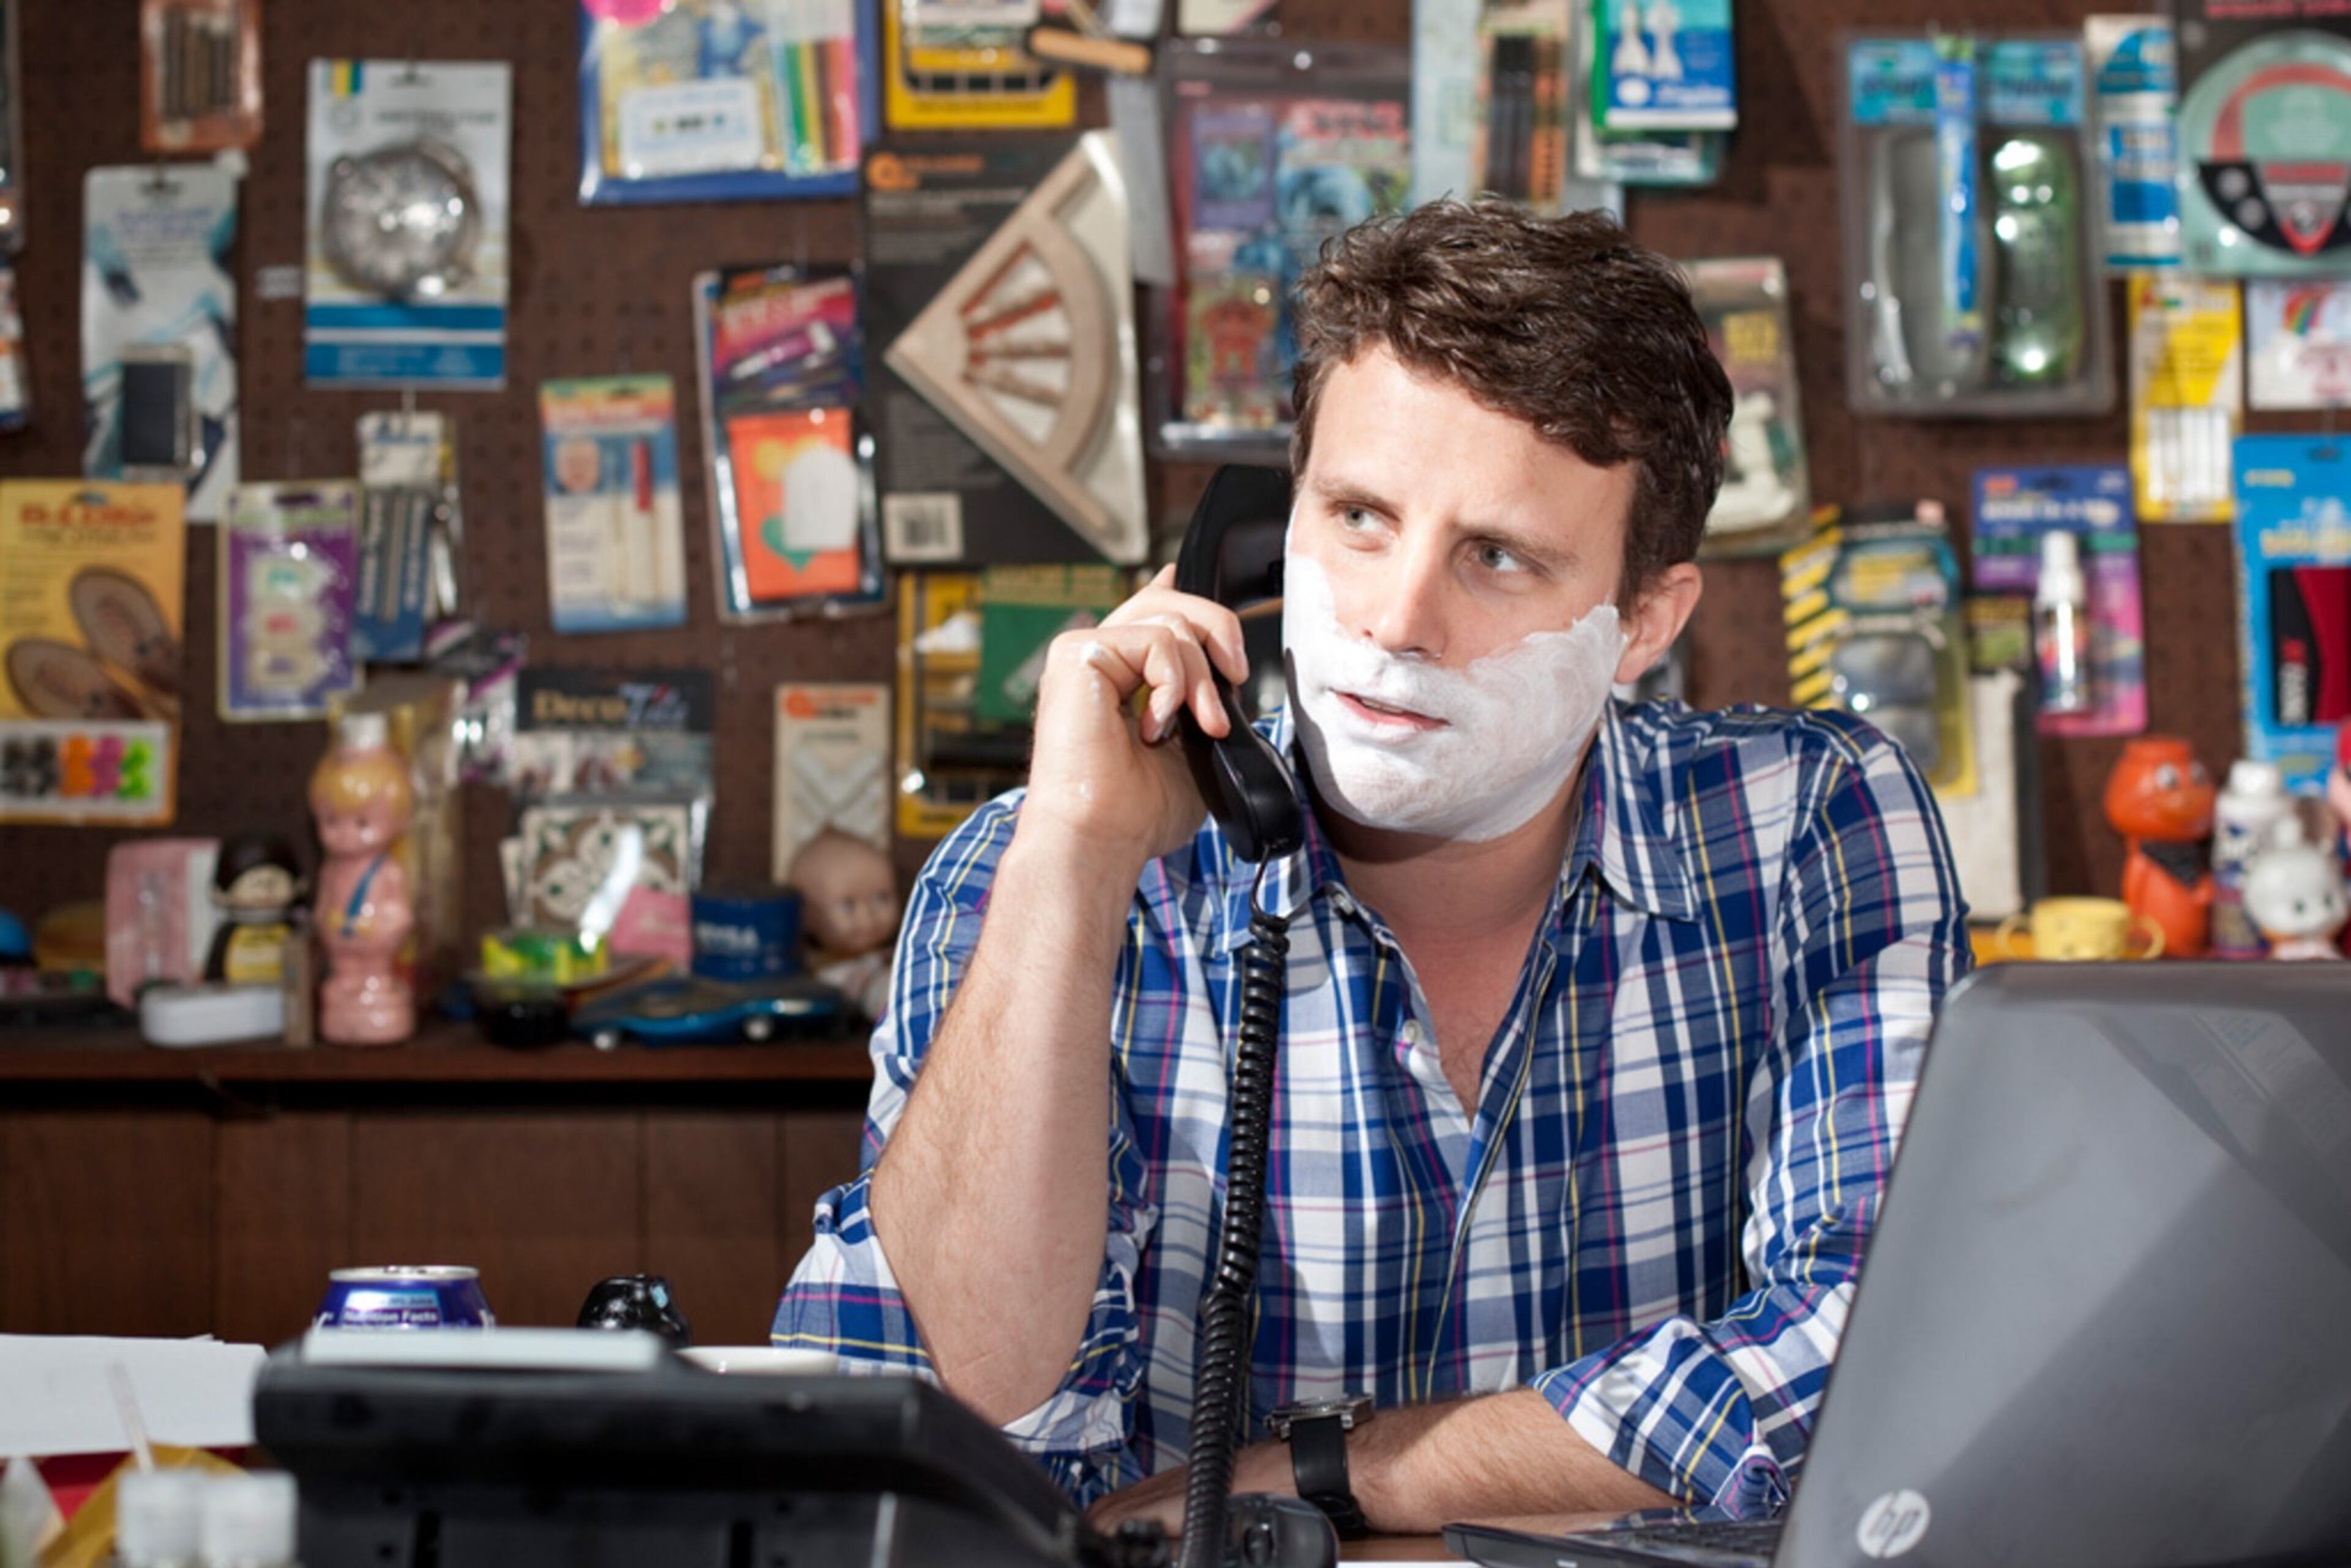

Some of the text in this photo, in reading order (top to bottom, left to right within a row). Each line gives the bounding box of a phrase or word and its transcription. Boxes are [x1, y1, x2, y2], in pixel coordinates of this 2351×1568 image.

[344, 1310, 438, 1322] Nutrition Facts
[1864, 1491, 1924, 1556] hp
